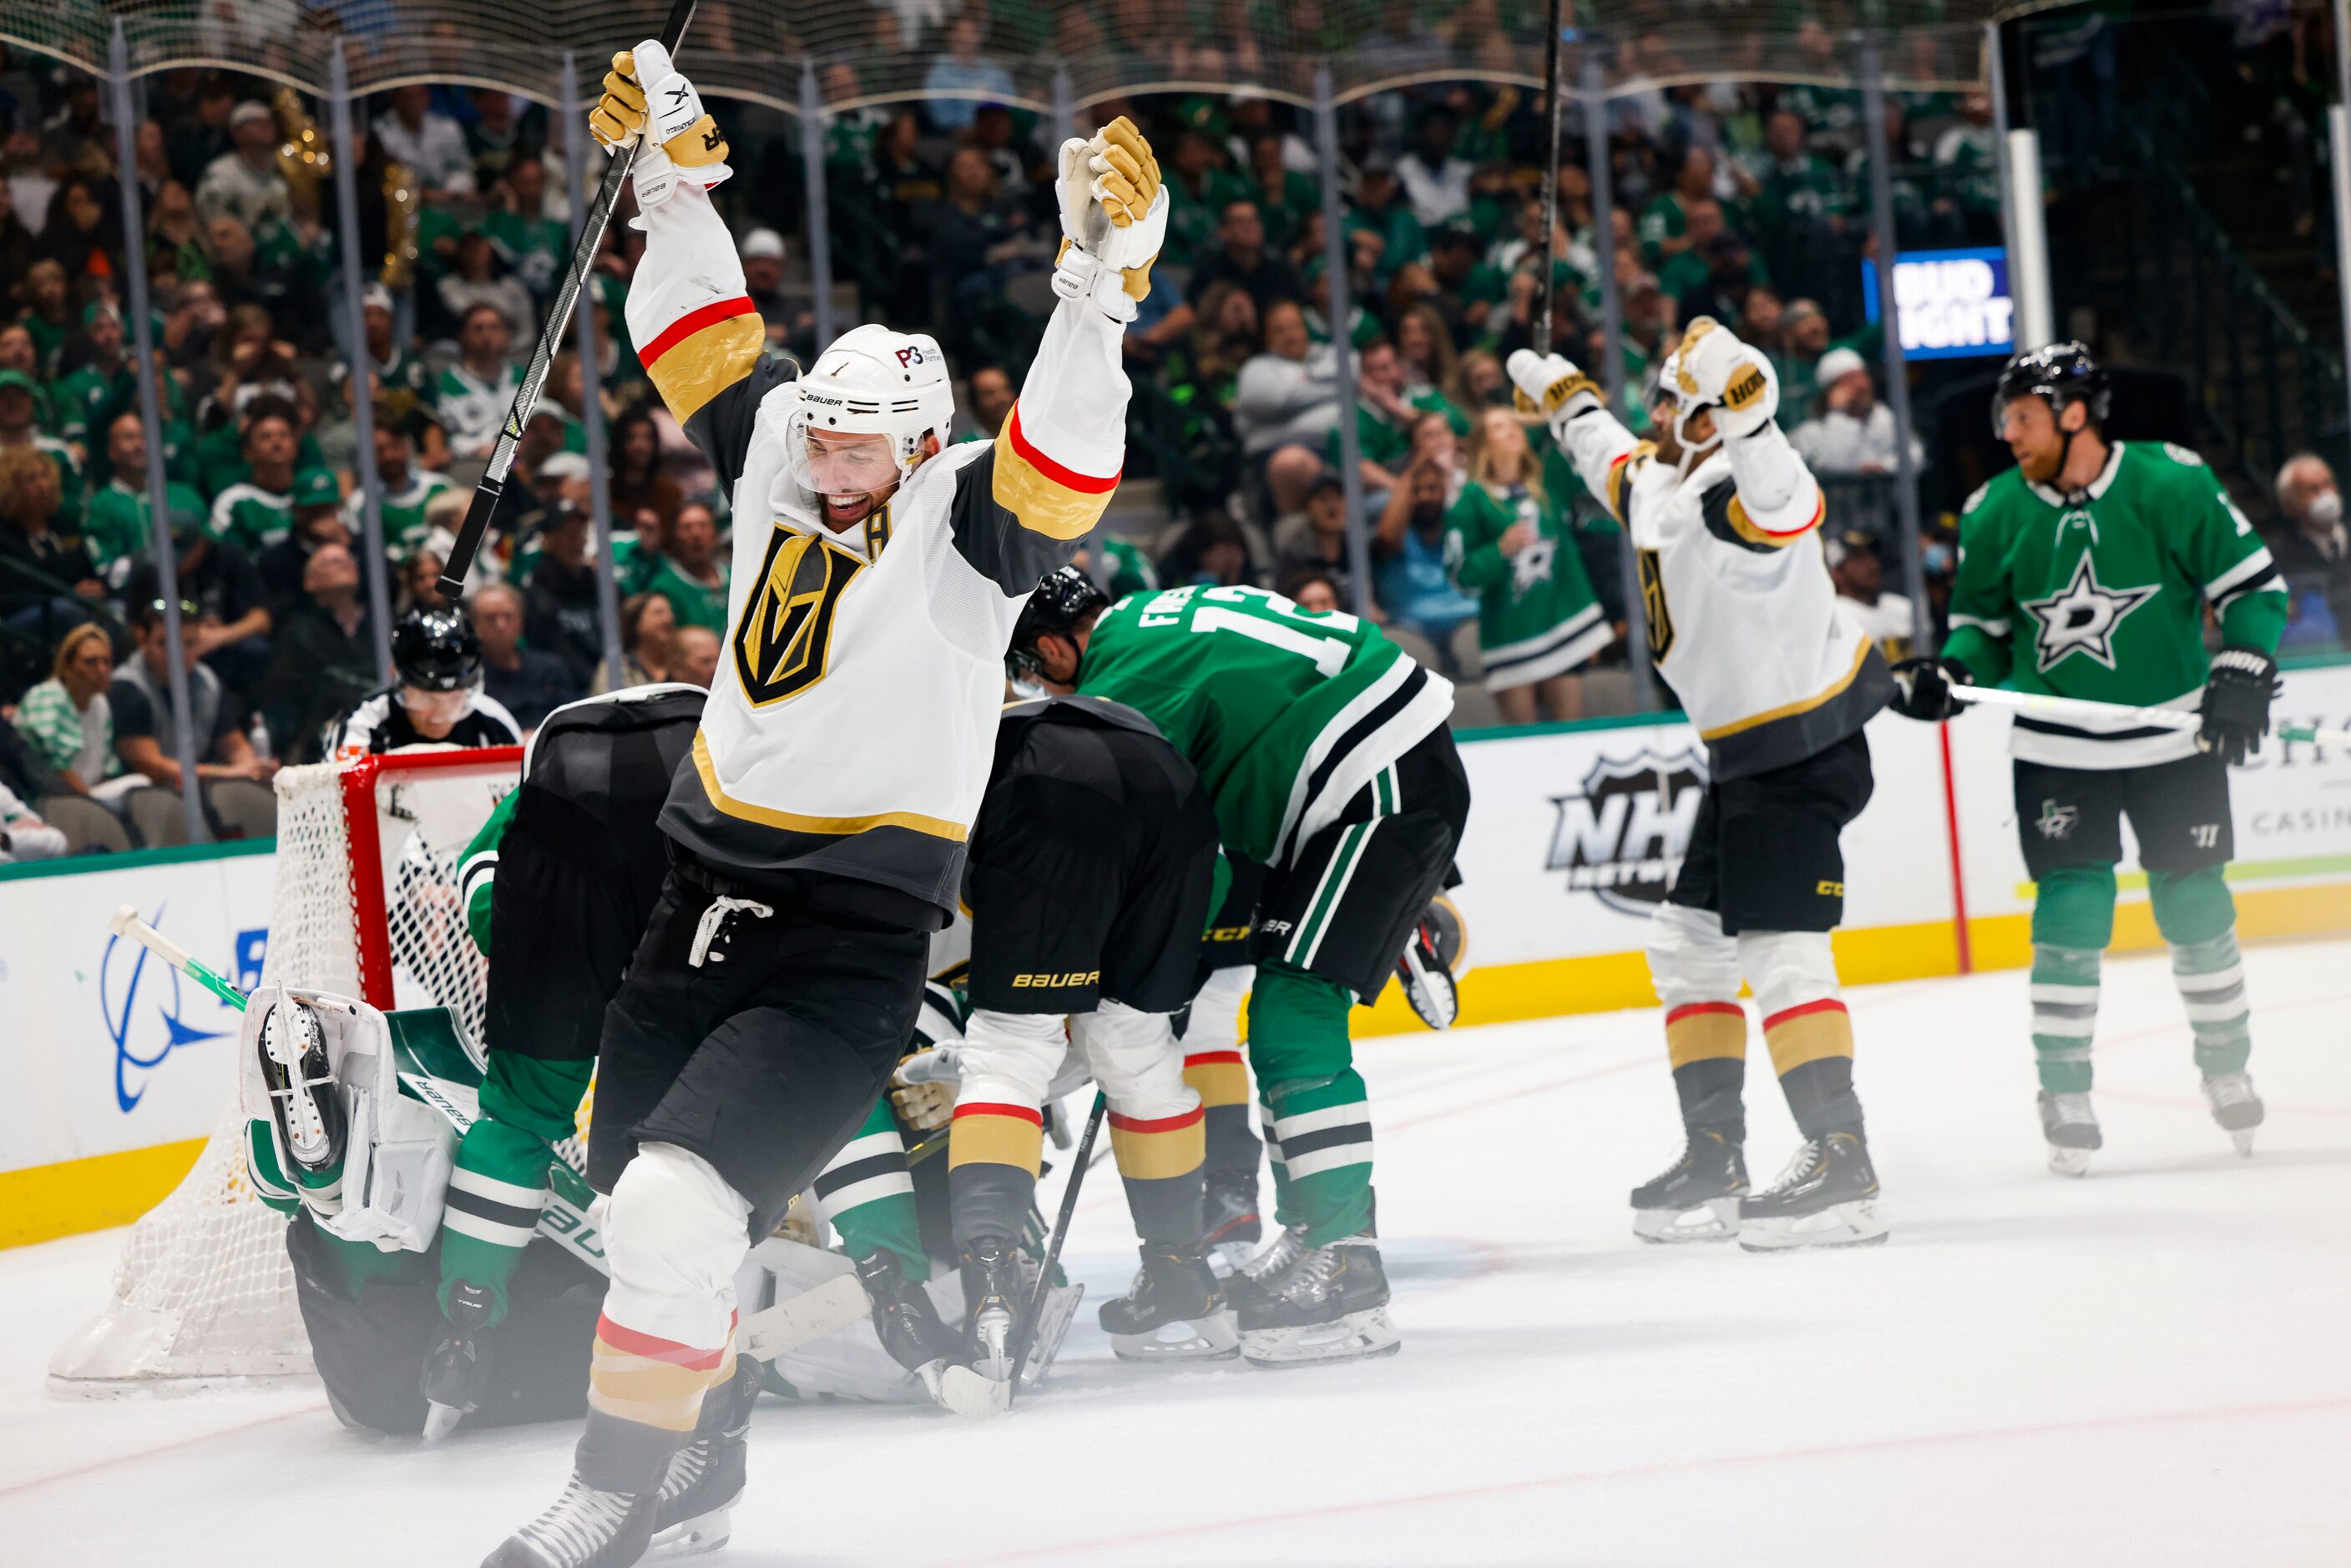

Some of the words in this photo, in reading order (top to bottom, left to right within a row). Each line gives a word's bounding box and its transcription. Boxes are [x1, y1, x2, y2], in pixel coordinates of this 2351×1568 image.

[641, 182, 666, 198] BAUER
[1058, 276, 1079, 291] BAUER
[1897, 296, 2014, 350] IGHT
[895, 346, 923, 369] P3
[806, 394, 842, 407] BAUER
[864, 504, 892, 563] A
[1191, 584, 1360, 679] 12
[1547, 785, 1705, 870] NH
[2252, 807, 2351, 836] CASIN
[1816, 880, 1843, 897] CC
[1011, 970, 1100, 987] BAUER
[415, 1080, 473, 1127] BAUER
